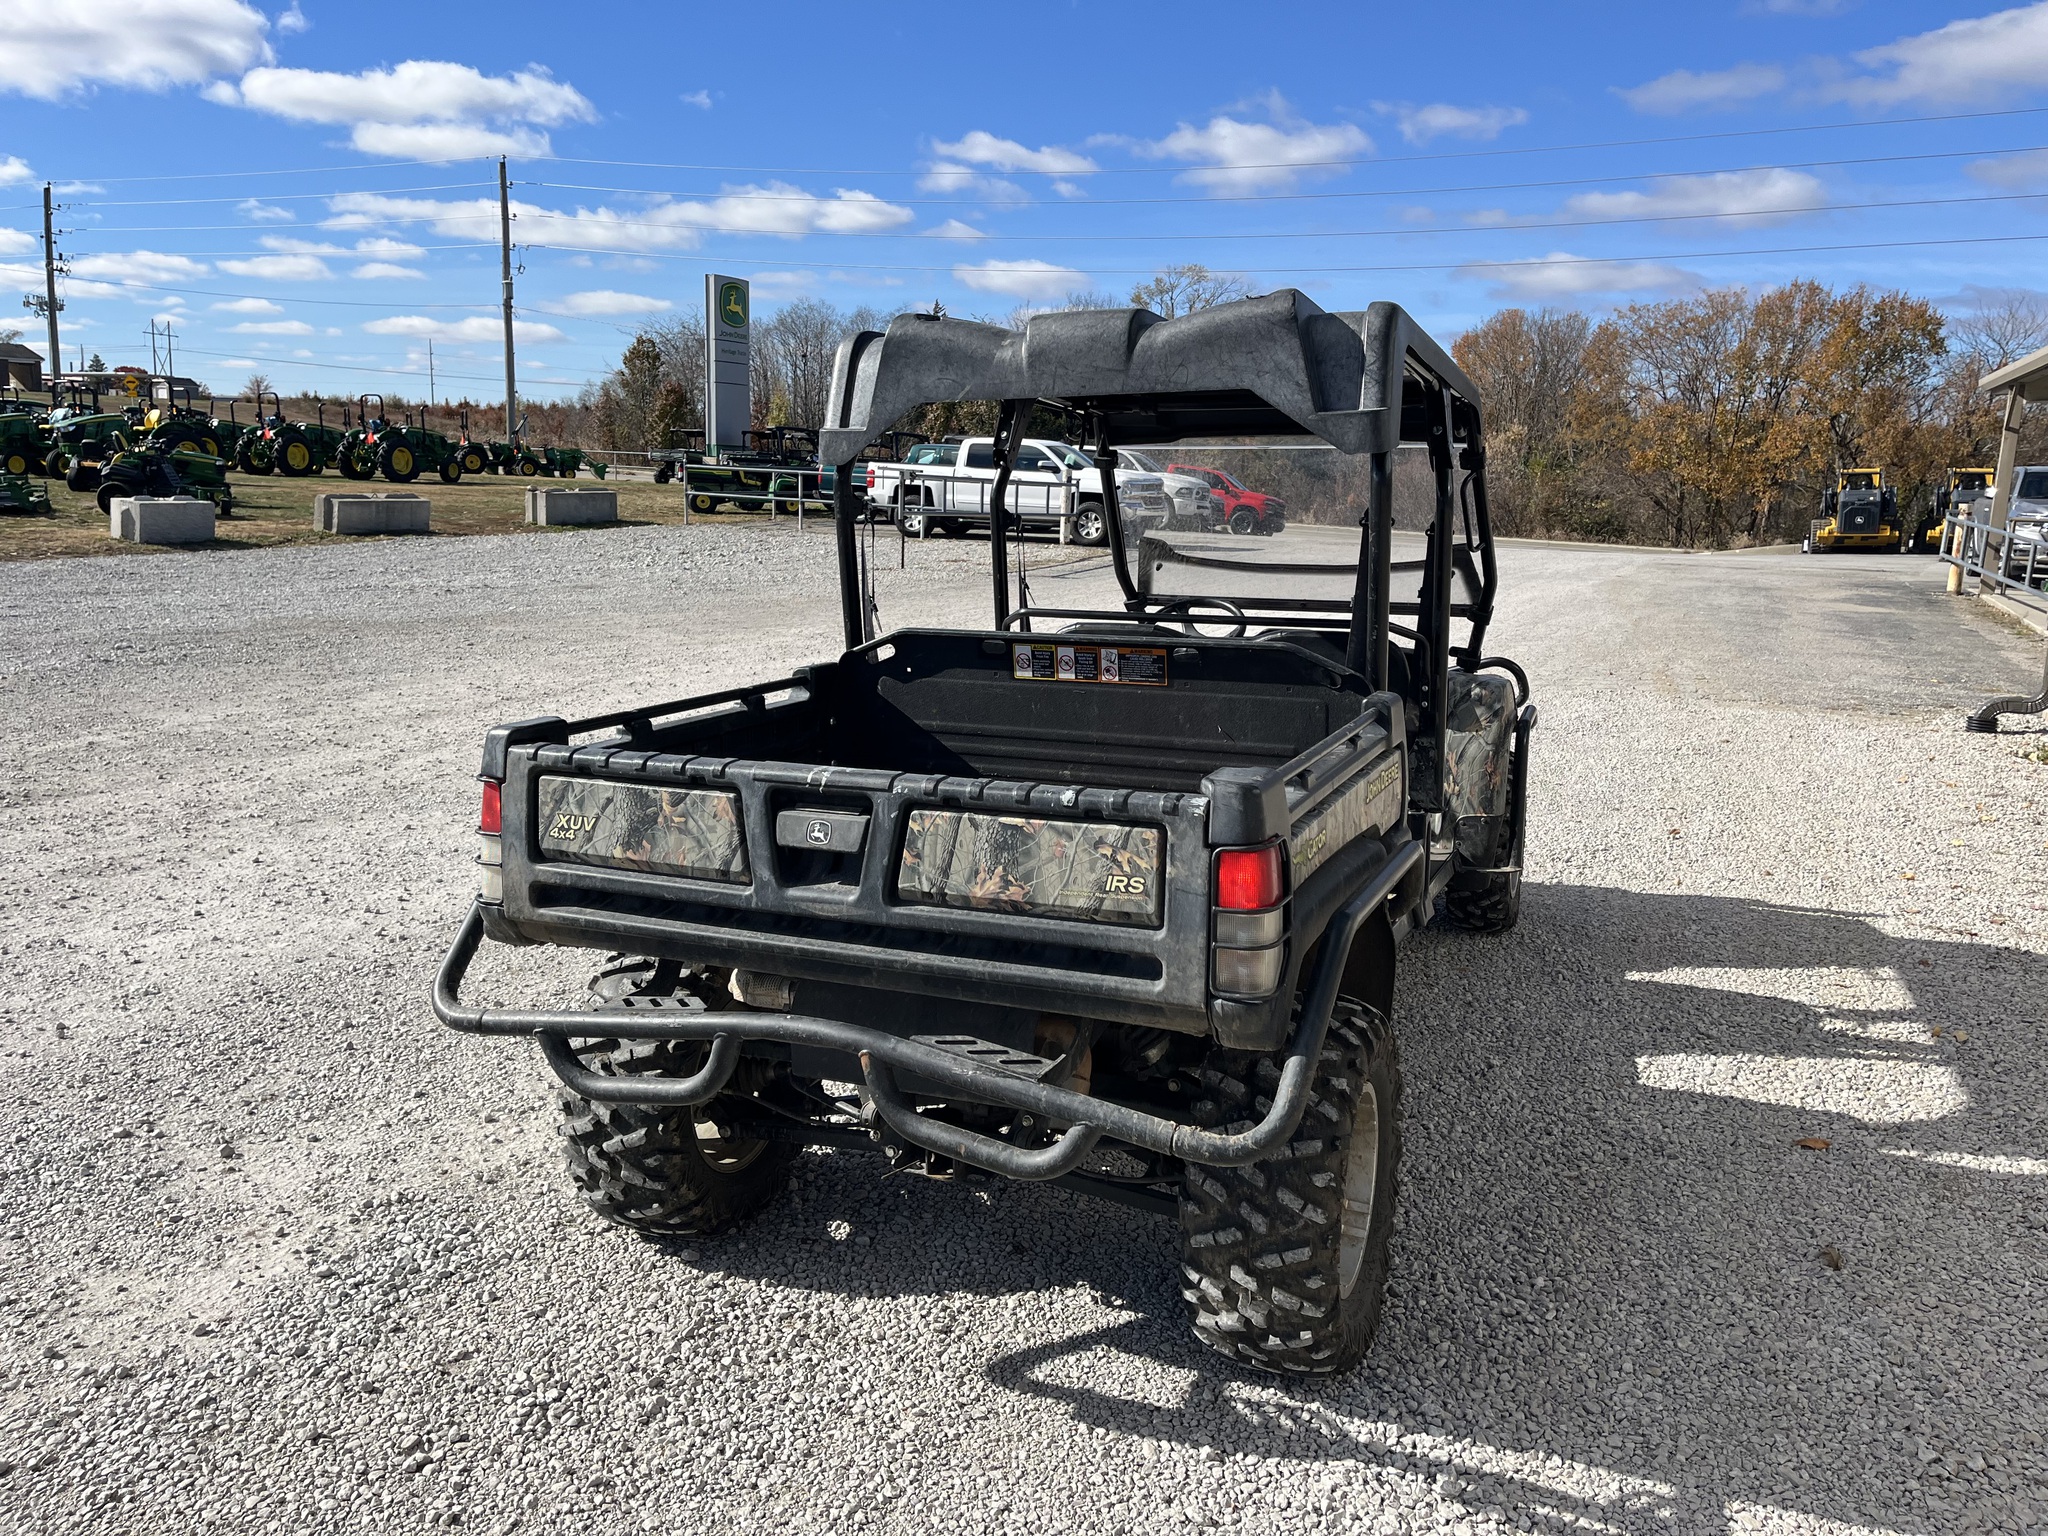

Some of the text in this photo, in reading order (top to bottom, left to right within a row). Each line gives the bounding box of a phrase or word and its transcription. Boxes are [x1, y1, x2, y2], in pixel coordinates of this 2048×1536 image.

[1366, 763, 1398, 803] JOHN DEERE
[556, 813, 596, 832] XUV
[549, 828, 576, 840] 4x4
[1307, 829, 1326, 859] GATOR
[1105, 875, 1146, 894] IRS
